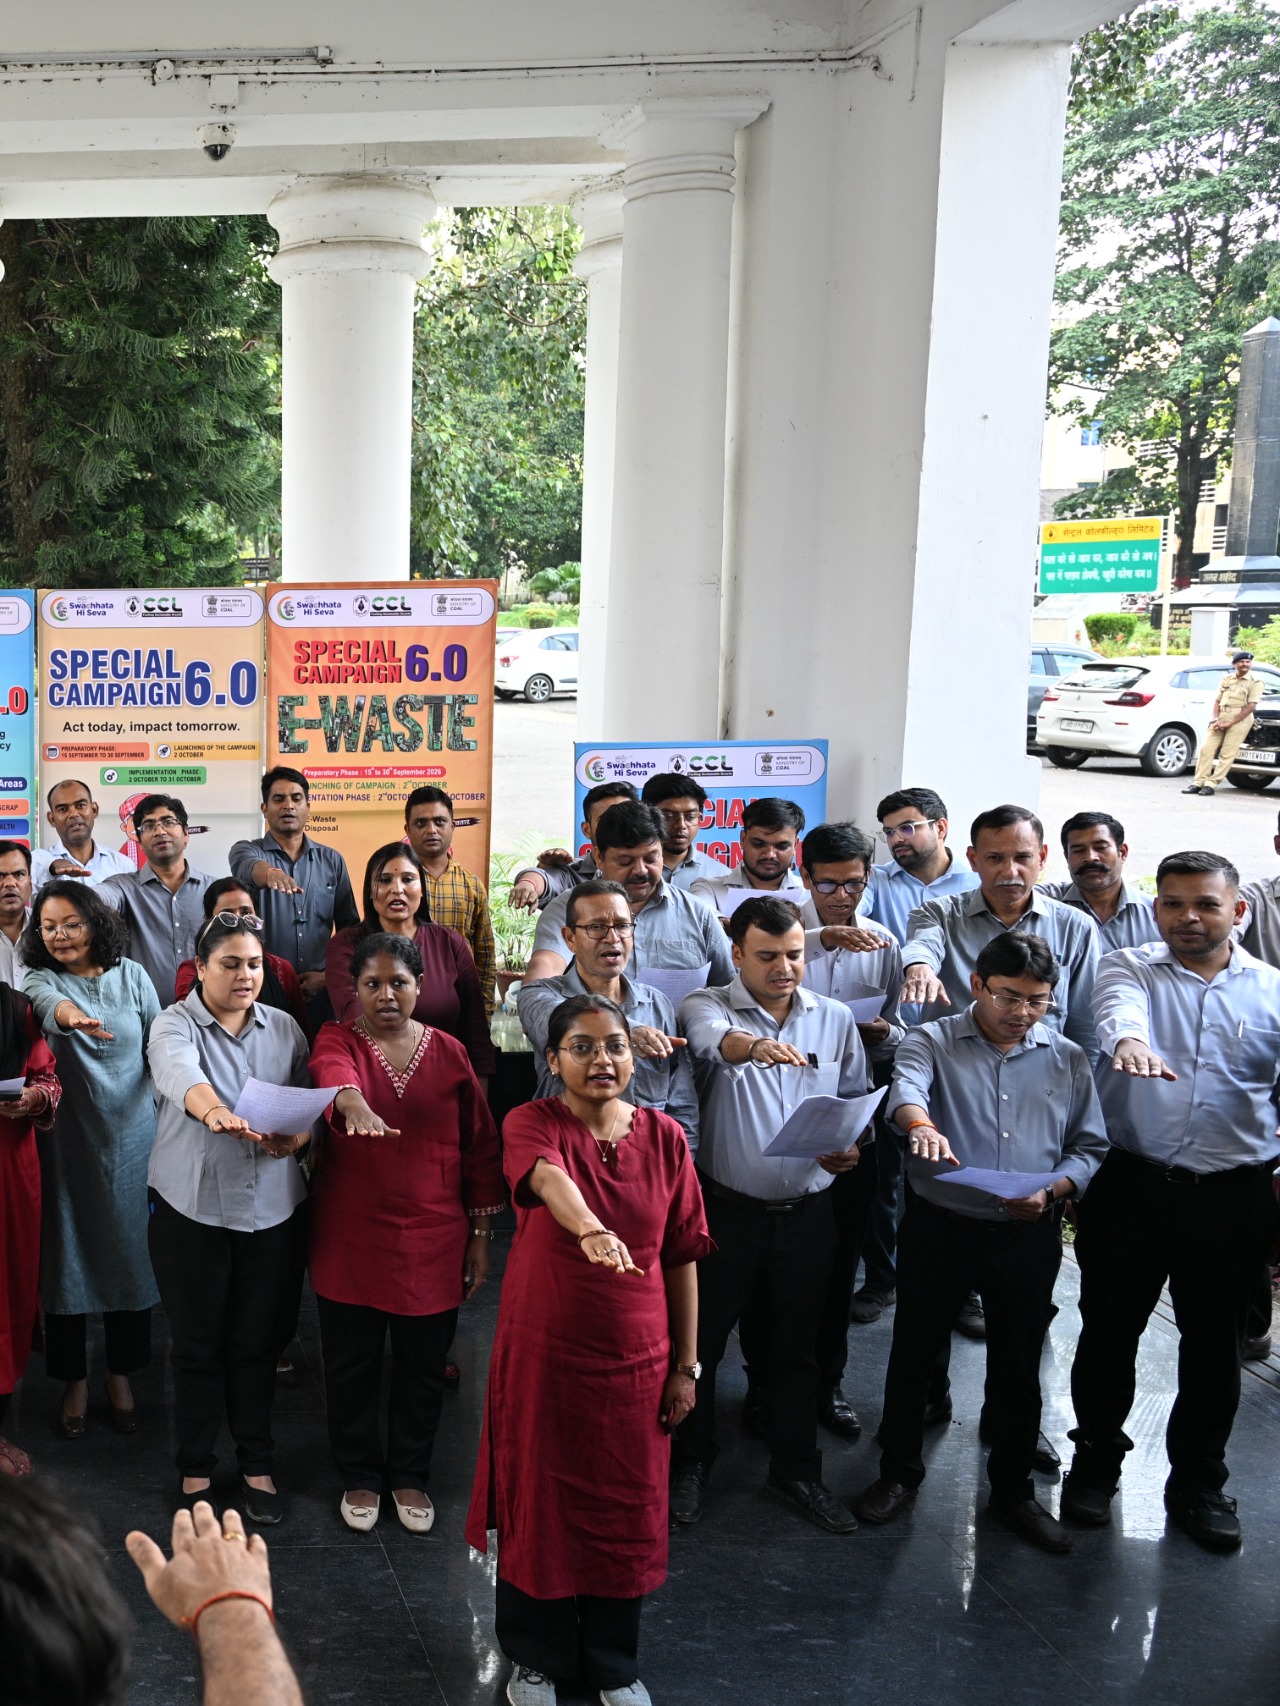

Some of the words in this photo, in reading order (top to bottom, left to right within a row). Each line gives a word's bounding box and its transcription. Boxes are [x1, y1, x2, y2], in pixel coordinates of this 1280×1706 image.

[1127, 524, 1154, 533] लिमिटेड
[69, 602, 114, 610] Swachhata
[144, 597, 182, 612] CCL
[297, 601, 341, 609] Swachhata
[372, 596, 412, 611] CCL
[294, 640, 401, 664] SPECIAL
[49, 650, 181, 680] SPECIAL
[293, 665, 401, 684] CAMPAIGN
[405, 644, 468, 682] 6.0
[48, 682, 181, 706] CAMPAIGN
[184, 661, 257, 706] 6.0
[63, 722, 85, 732] Act
[88, 722, 126, 734] today,
[130, 721, 173, 734] impact
[176, 722, 240, 732] tomorrow.
[278, 694, 478, 753] E-WASTE
[606, 761, 656, 770] Swachhata
[689, 755, 733, 771] CCL
[304, 769, 339, 777] Preparatory
[393, 768, 425, 776] September
[355, 781, 396, 789] CAMPAIGN
[346, 793, 371, 801] PHASE
